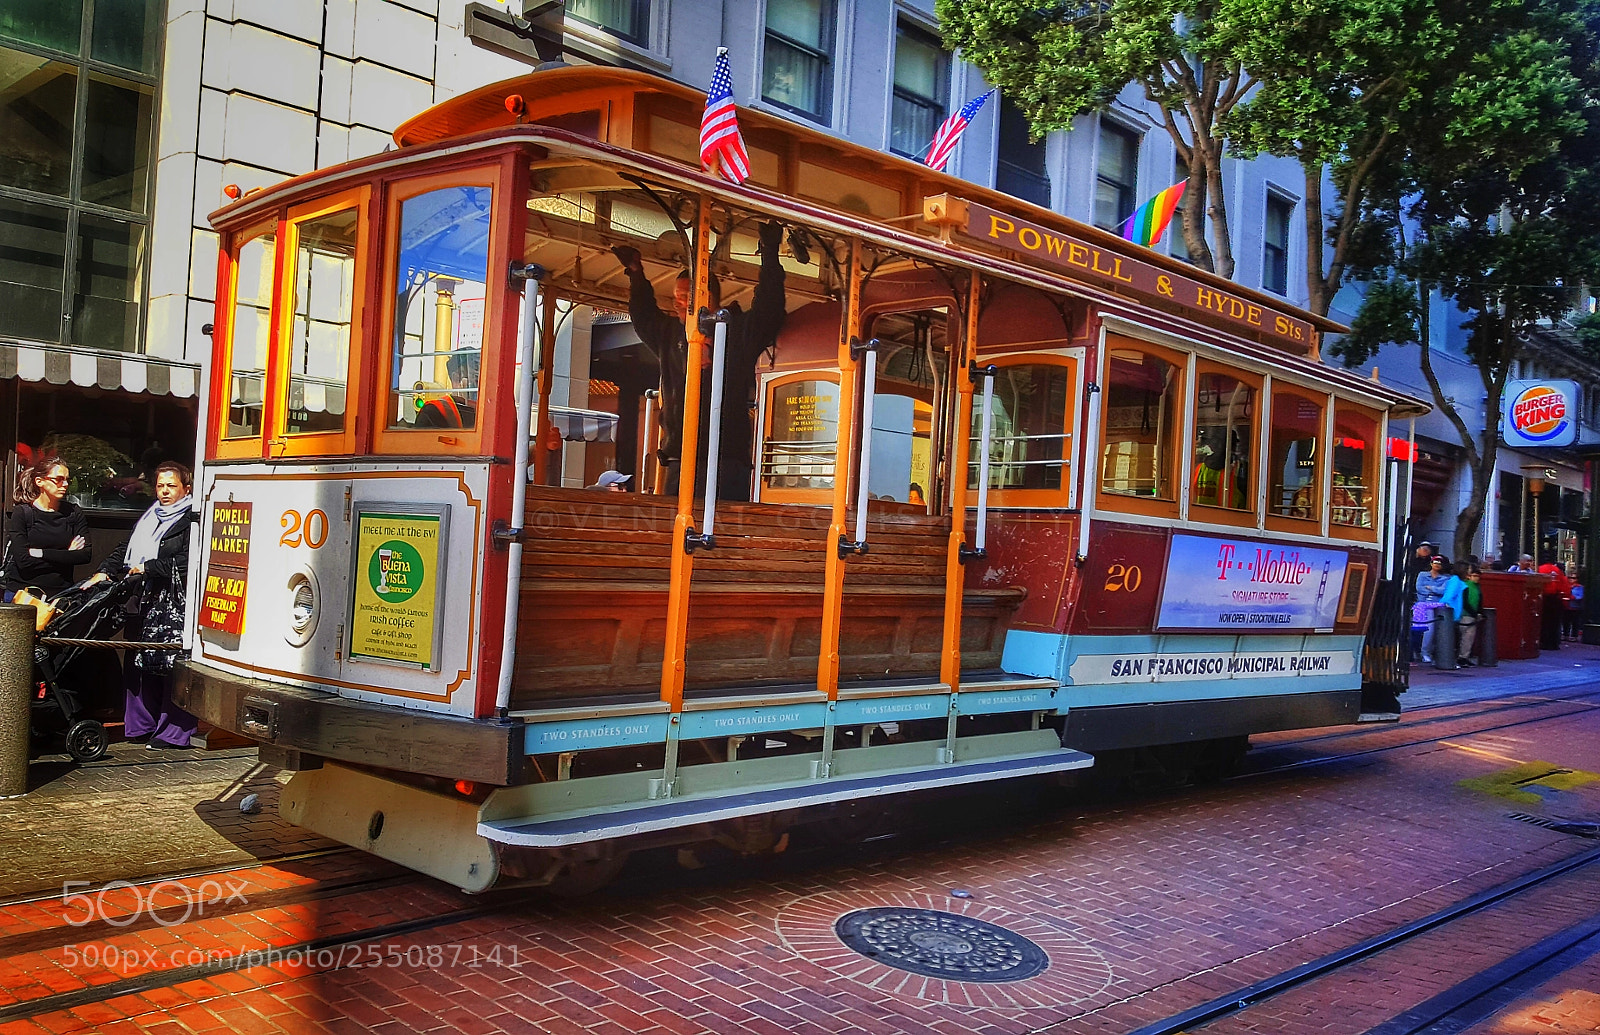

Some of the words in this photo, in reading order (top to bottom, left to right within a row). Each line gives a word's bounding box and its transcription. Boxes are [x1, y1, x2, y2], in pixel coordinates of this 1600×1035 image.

[988, 213, 1133, 284] POWELL
[1155, 274, 1174, 298] &
[1196, 286, 1263, 327] HYDE
[1274, 315, 1306, 343] Sts.
[1515, 395, 1563, 415] BURGER
[1517, 404, 1565, 430] KING
[213, 508, 250, 525] POWELL
[221, 524, 241, 537] AND
[279, 509, 329, 549] 20
[211, 537, 249, 554] MARKET
[1104, 564, 1142, 592] 20
[206, 576, 221, 593] HYDE
[225, 577, 245, 598] BEACH
[210, 610, 228, 624] WHARF
[1219, 613, 1232, 623] NOW
[1231, 613, 1246, 624] OPEN
[1249, 614, 1275, 624] STOCKTON
[1279, 615, 1292, 624] ELLIS
[1110, 659, 1143, 677] SAN
[1147, 657, 1223, 675] FRANCISCO
[1227, 657, 1286, 673] MUNICIPAL
[1289, 656, 1332, 671] RAILWAY
[861, 706, 877, 715] TWO
[915, 703, 931, 712] ONLY
[714, 718, 734, 728] TWO
[736, 715, 778, 726] STANDEES
[779, 713, 800, 722] ONLY
[543, 731, 567, 742] TWO
[571, 728, 621, 739] STANDEES
[624, 725, 650, 735] ONLY
